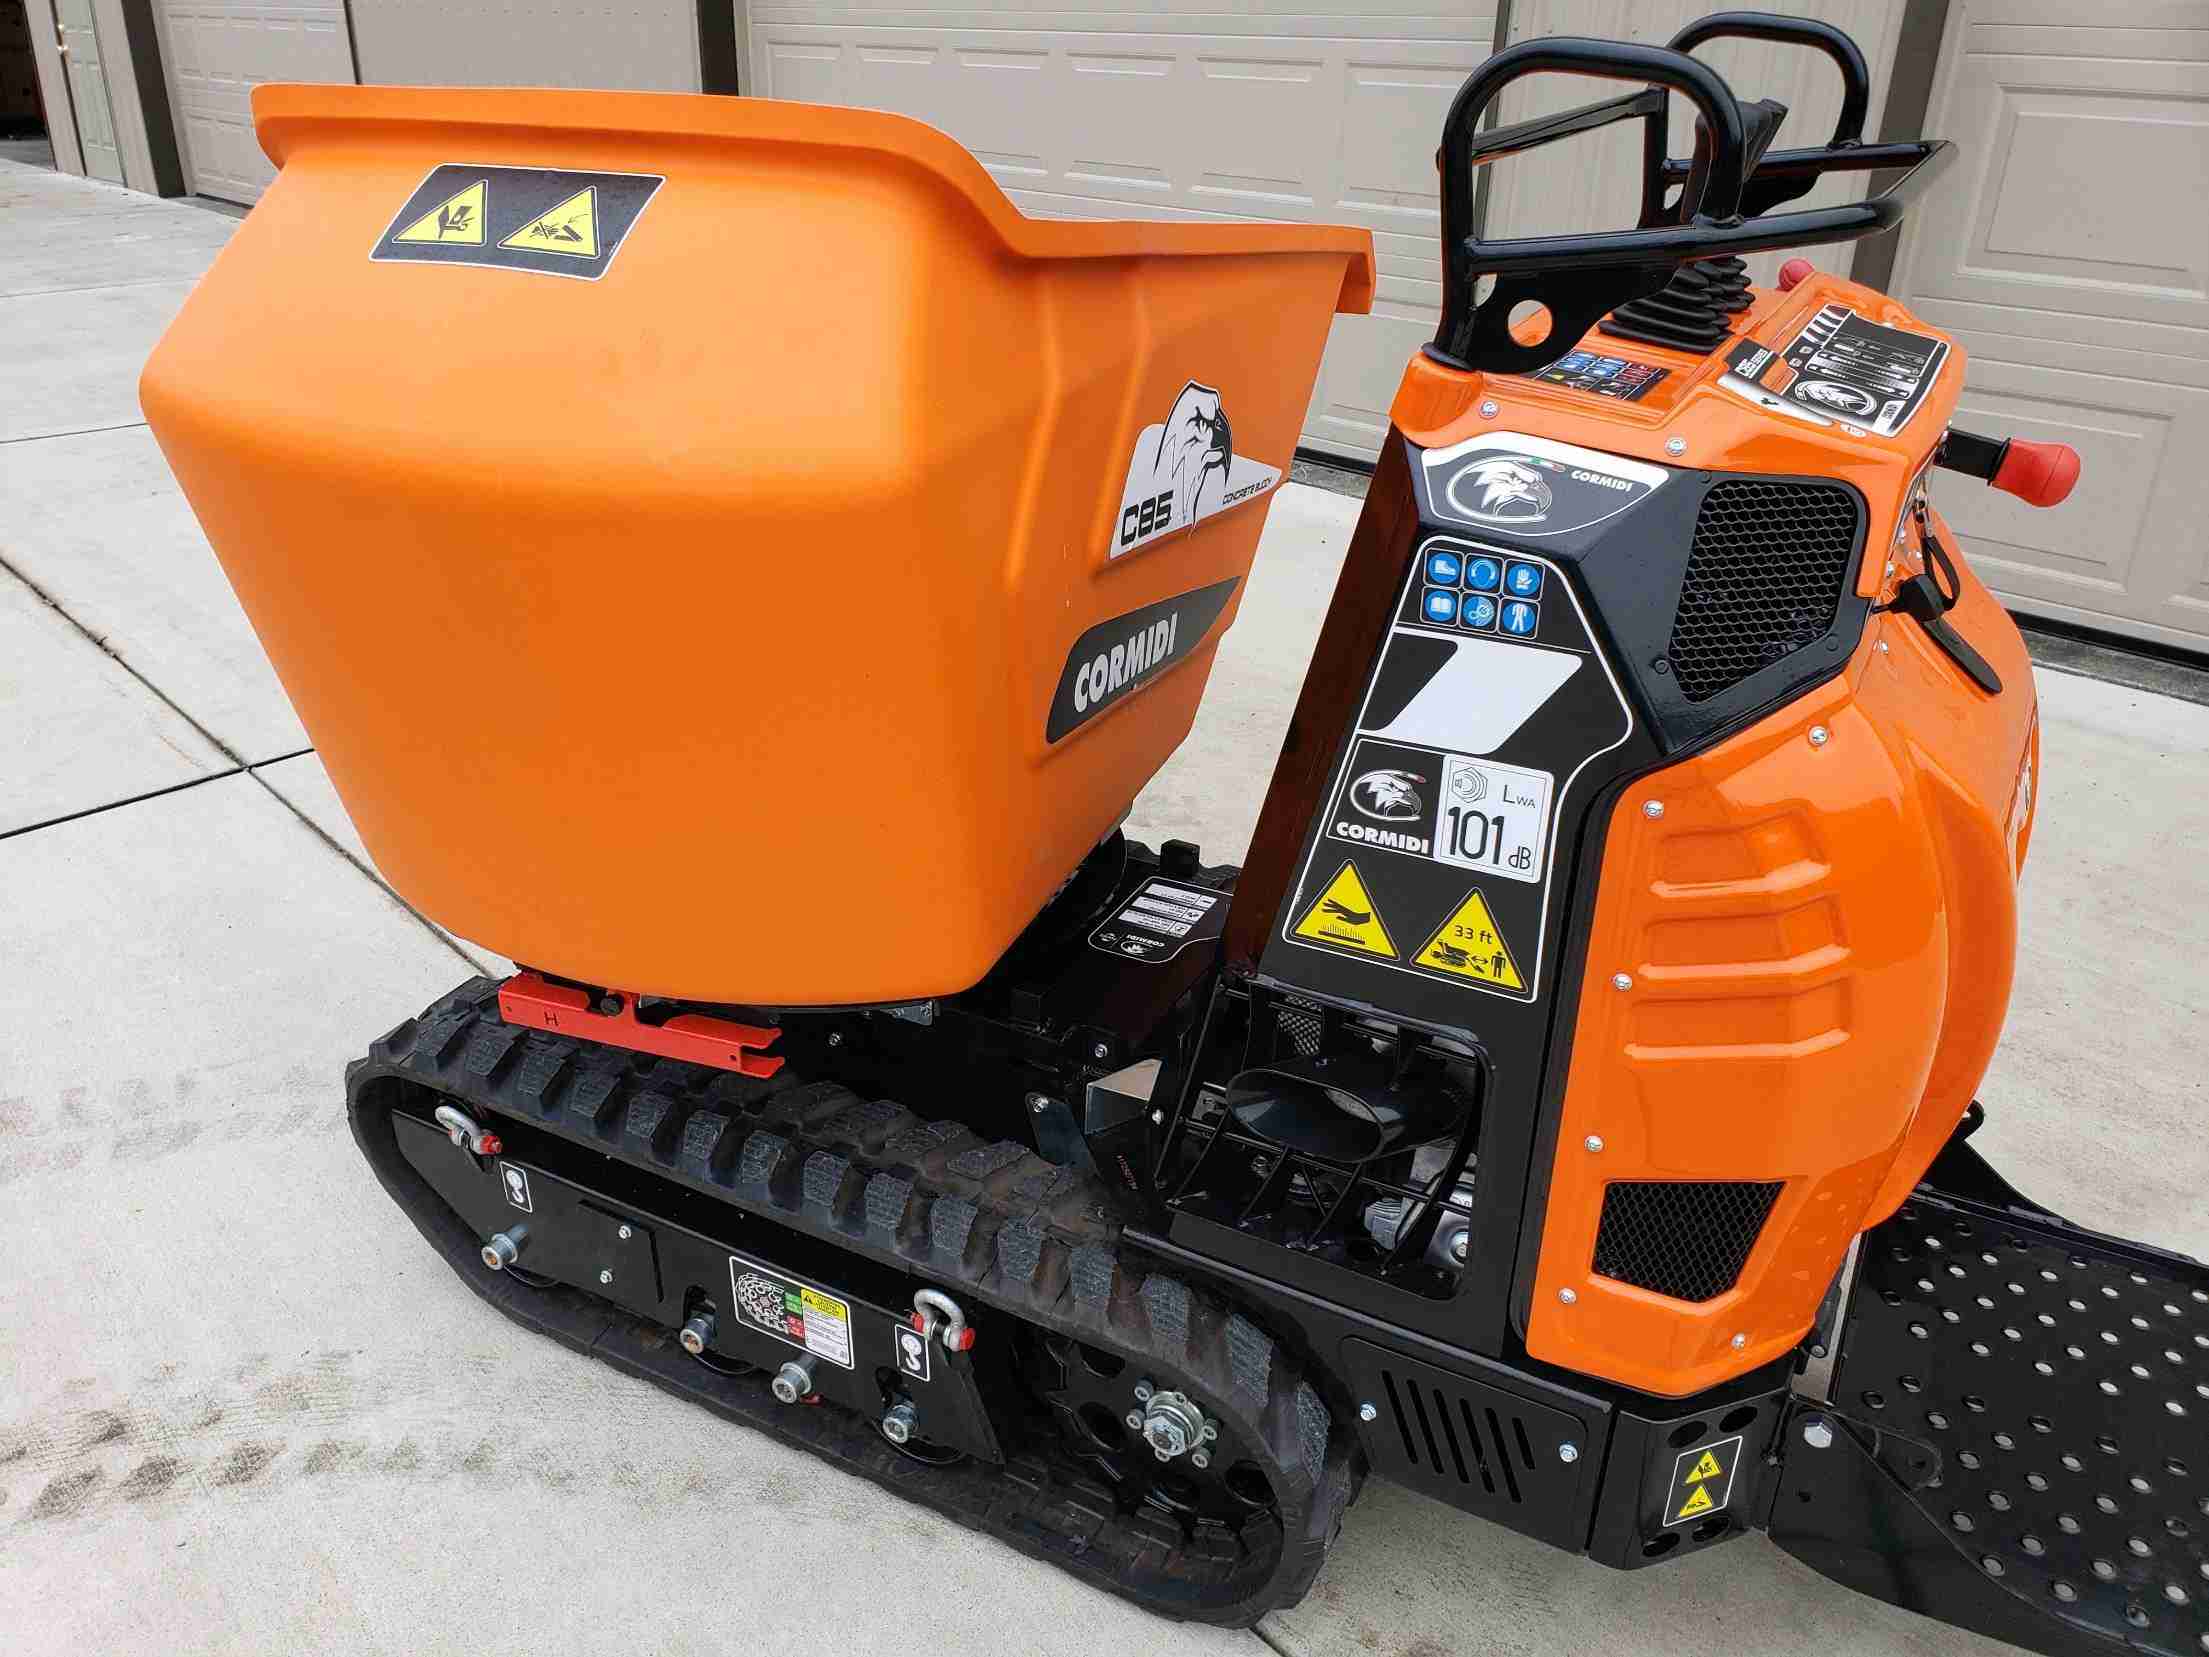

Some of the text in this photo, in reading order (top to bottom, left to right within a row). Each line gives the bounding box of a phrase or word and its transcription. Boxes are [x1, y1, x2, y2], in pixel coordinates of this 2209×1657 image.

[1571, 470, 1633, 492] CORMIDI
[1120, 490, 1174, 546] C85
[1074, 612, 1178, 713] CORMIDI
[1336, 822, 1430, 855] CORMIDI
[1447, 806, 1505, 865] 101
[1508, 845, 1532, 870] dB
[1454, 924, 1492, 945] 33 ft
[543, 1011, 559, 1027] H
